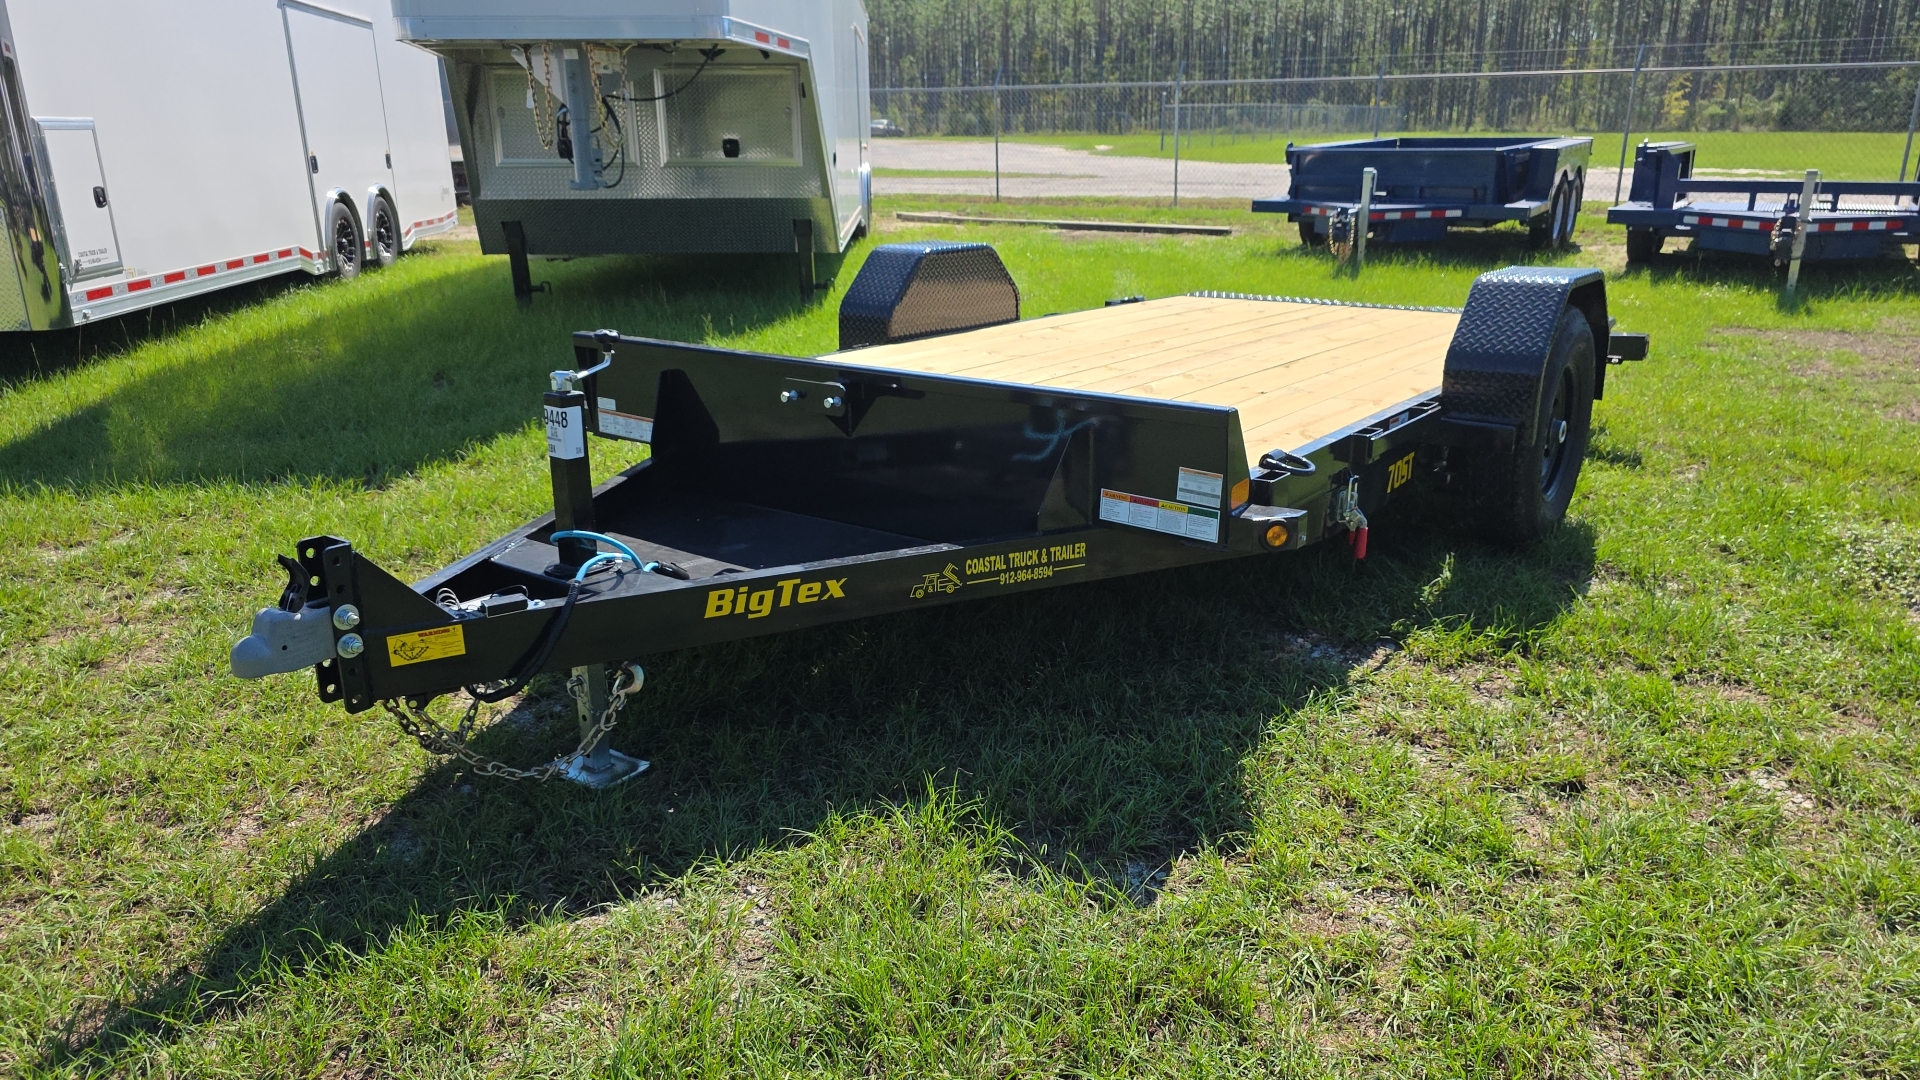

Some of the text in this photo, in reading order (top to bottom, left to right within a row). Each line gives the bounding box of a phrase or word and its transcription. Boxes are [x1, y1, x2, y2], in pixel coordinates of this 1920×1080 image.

[965, 542, 1086, 576] COASTAL TRUCK & TRAILER
[999, 565, 1053, 586] 912-964-8594
[703, 578, 848, 619] BigTex
